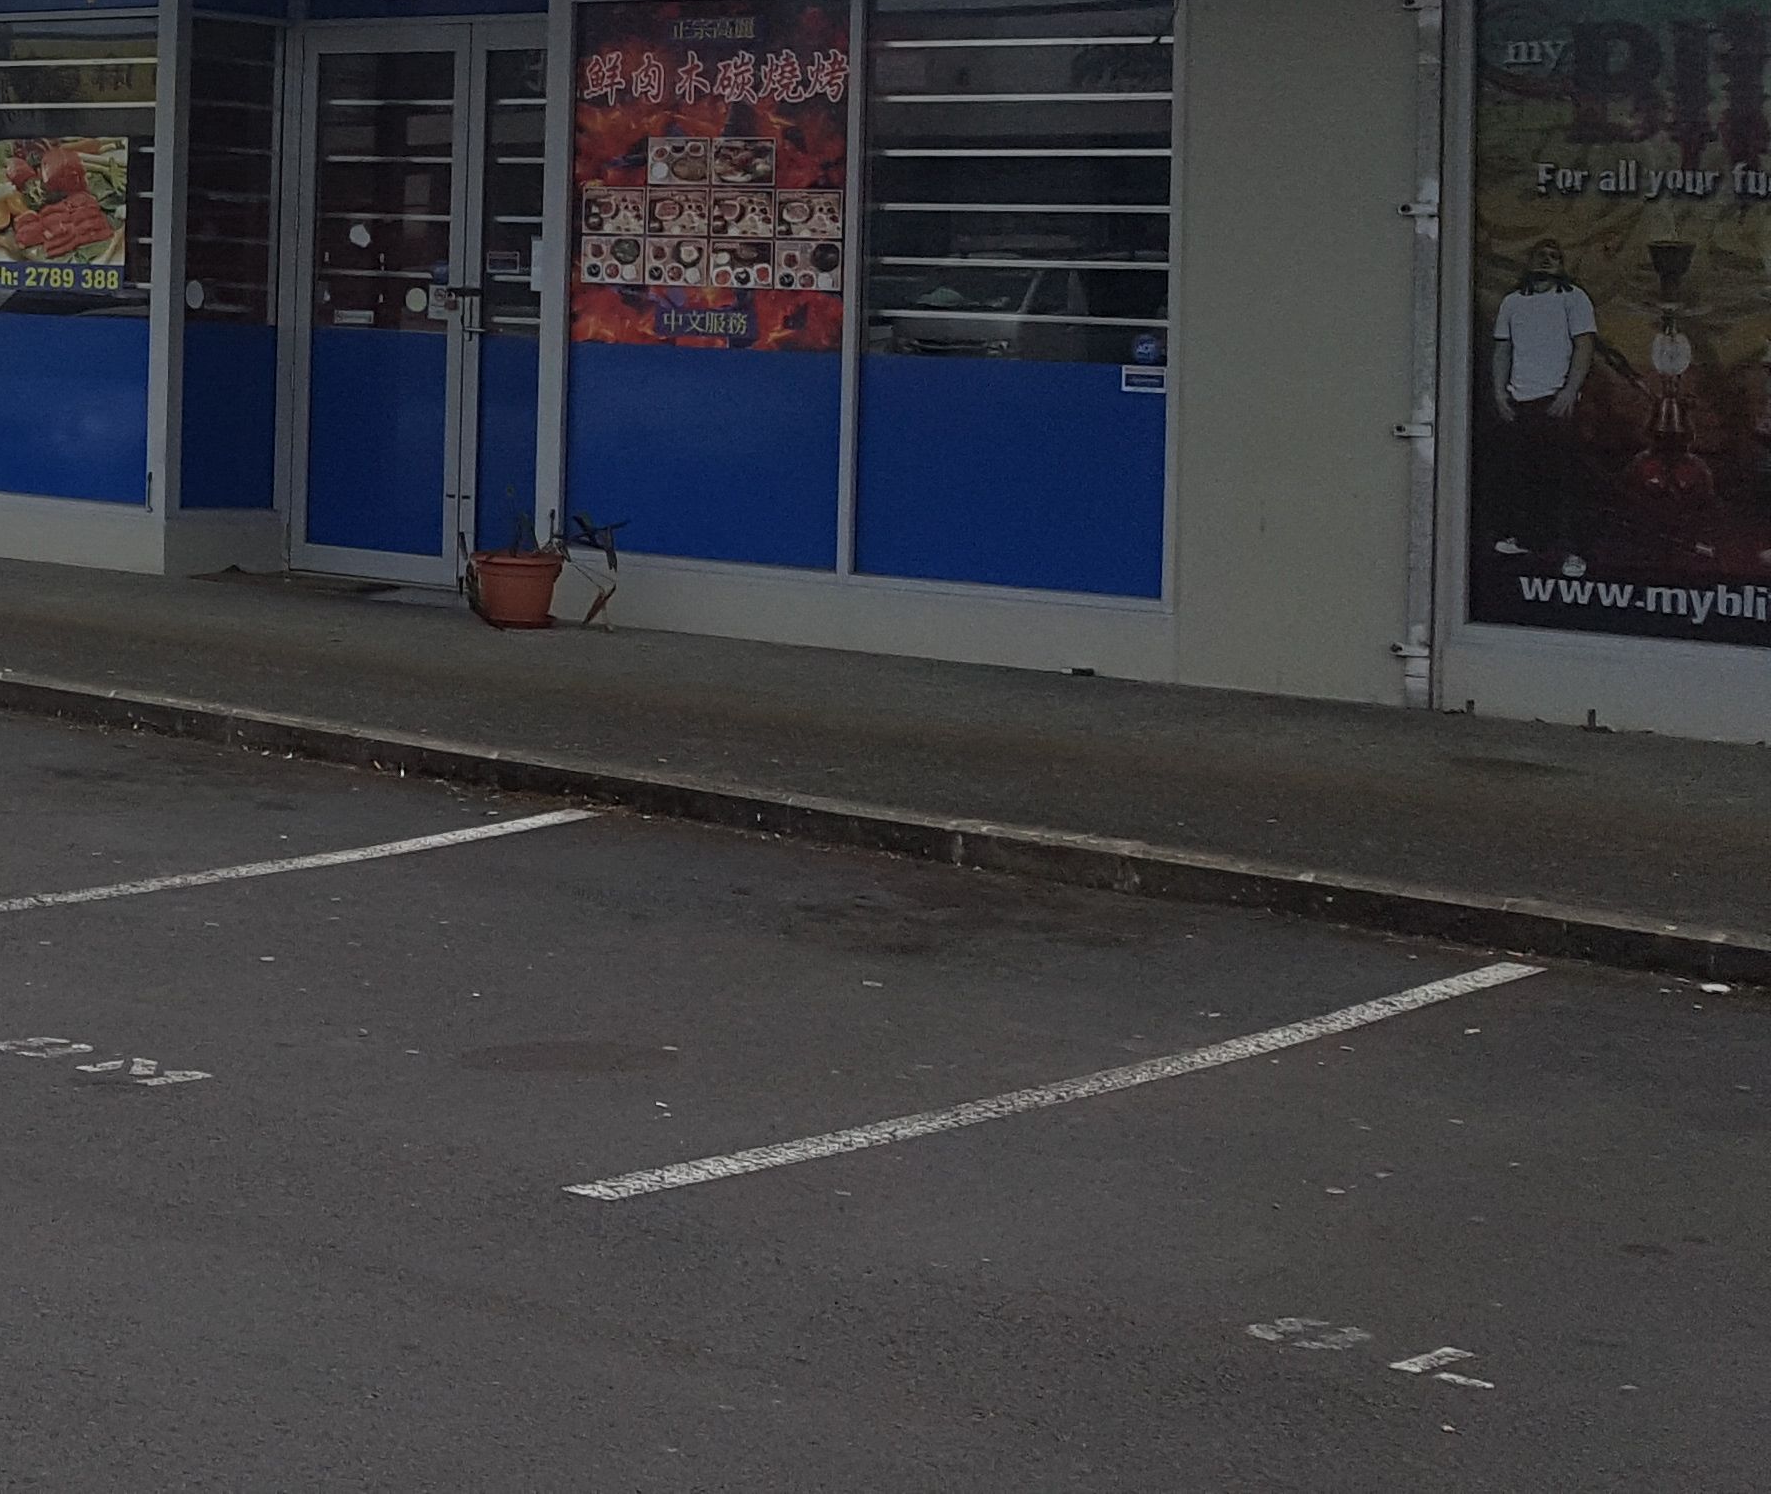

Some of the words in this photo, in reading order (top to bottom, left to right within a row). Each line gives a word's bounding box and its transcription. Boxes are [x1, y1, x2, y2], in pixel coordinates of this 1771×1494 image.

[1504, 41, 1566, 73] my
[1535, 161, 1588, 193] For
[1598, 158, 1638, 192] all
[1643, 168, 1720, 199] your
[25, 266, 75, 290] 2789
[80, 268, 120, 292] 388
[662, 309, 749, 336] 中文服務
